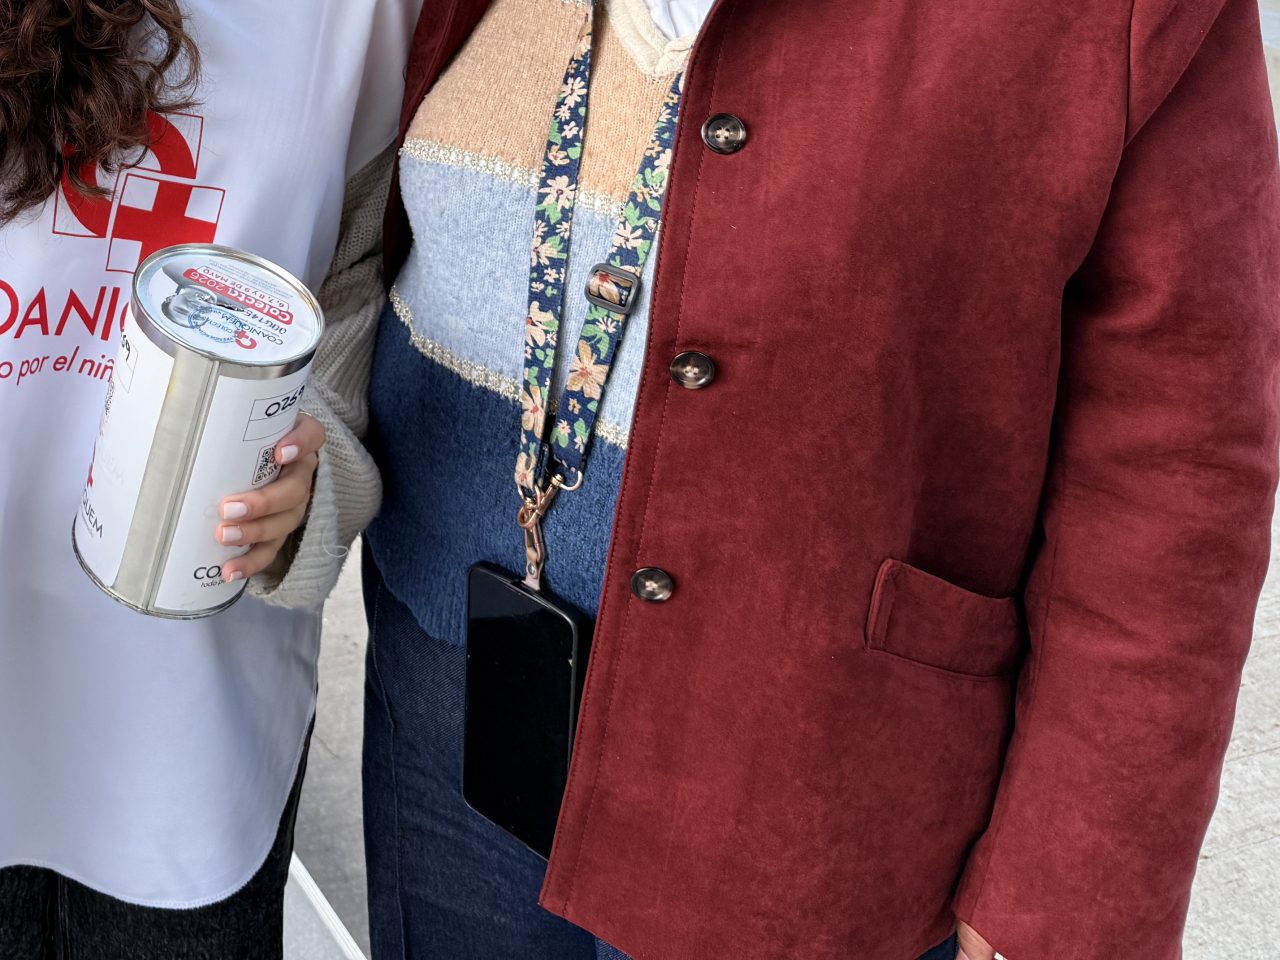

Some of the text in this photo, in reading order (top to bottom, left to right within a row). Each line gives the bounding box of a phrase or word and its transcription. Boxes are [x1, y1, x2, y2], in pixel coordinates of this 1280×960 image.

[190, 271, 225, 291] 2026
[227, 289, 291, 321] Colecta
[16, 355, 51, 386] por
[52, 346, 80, 372] el
